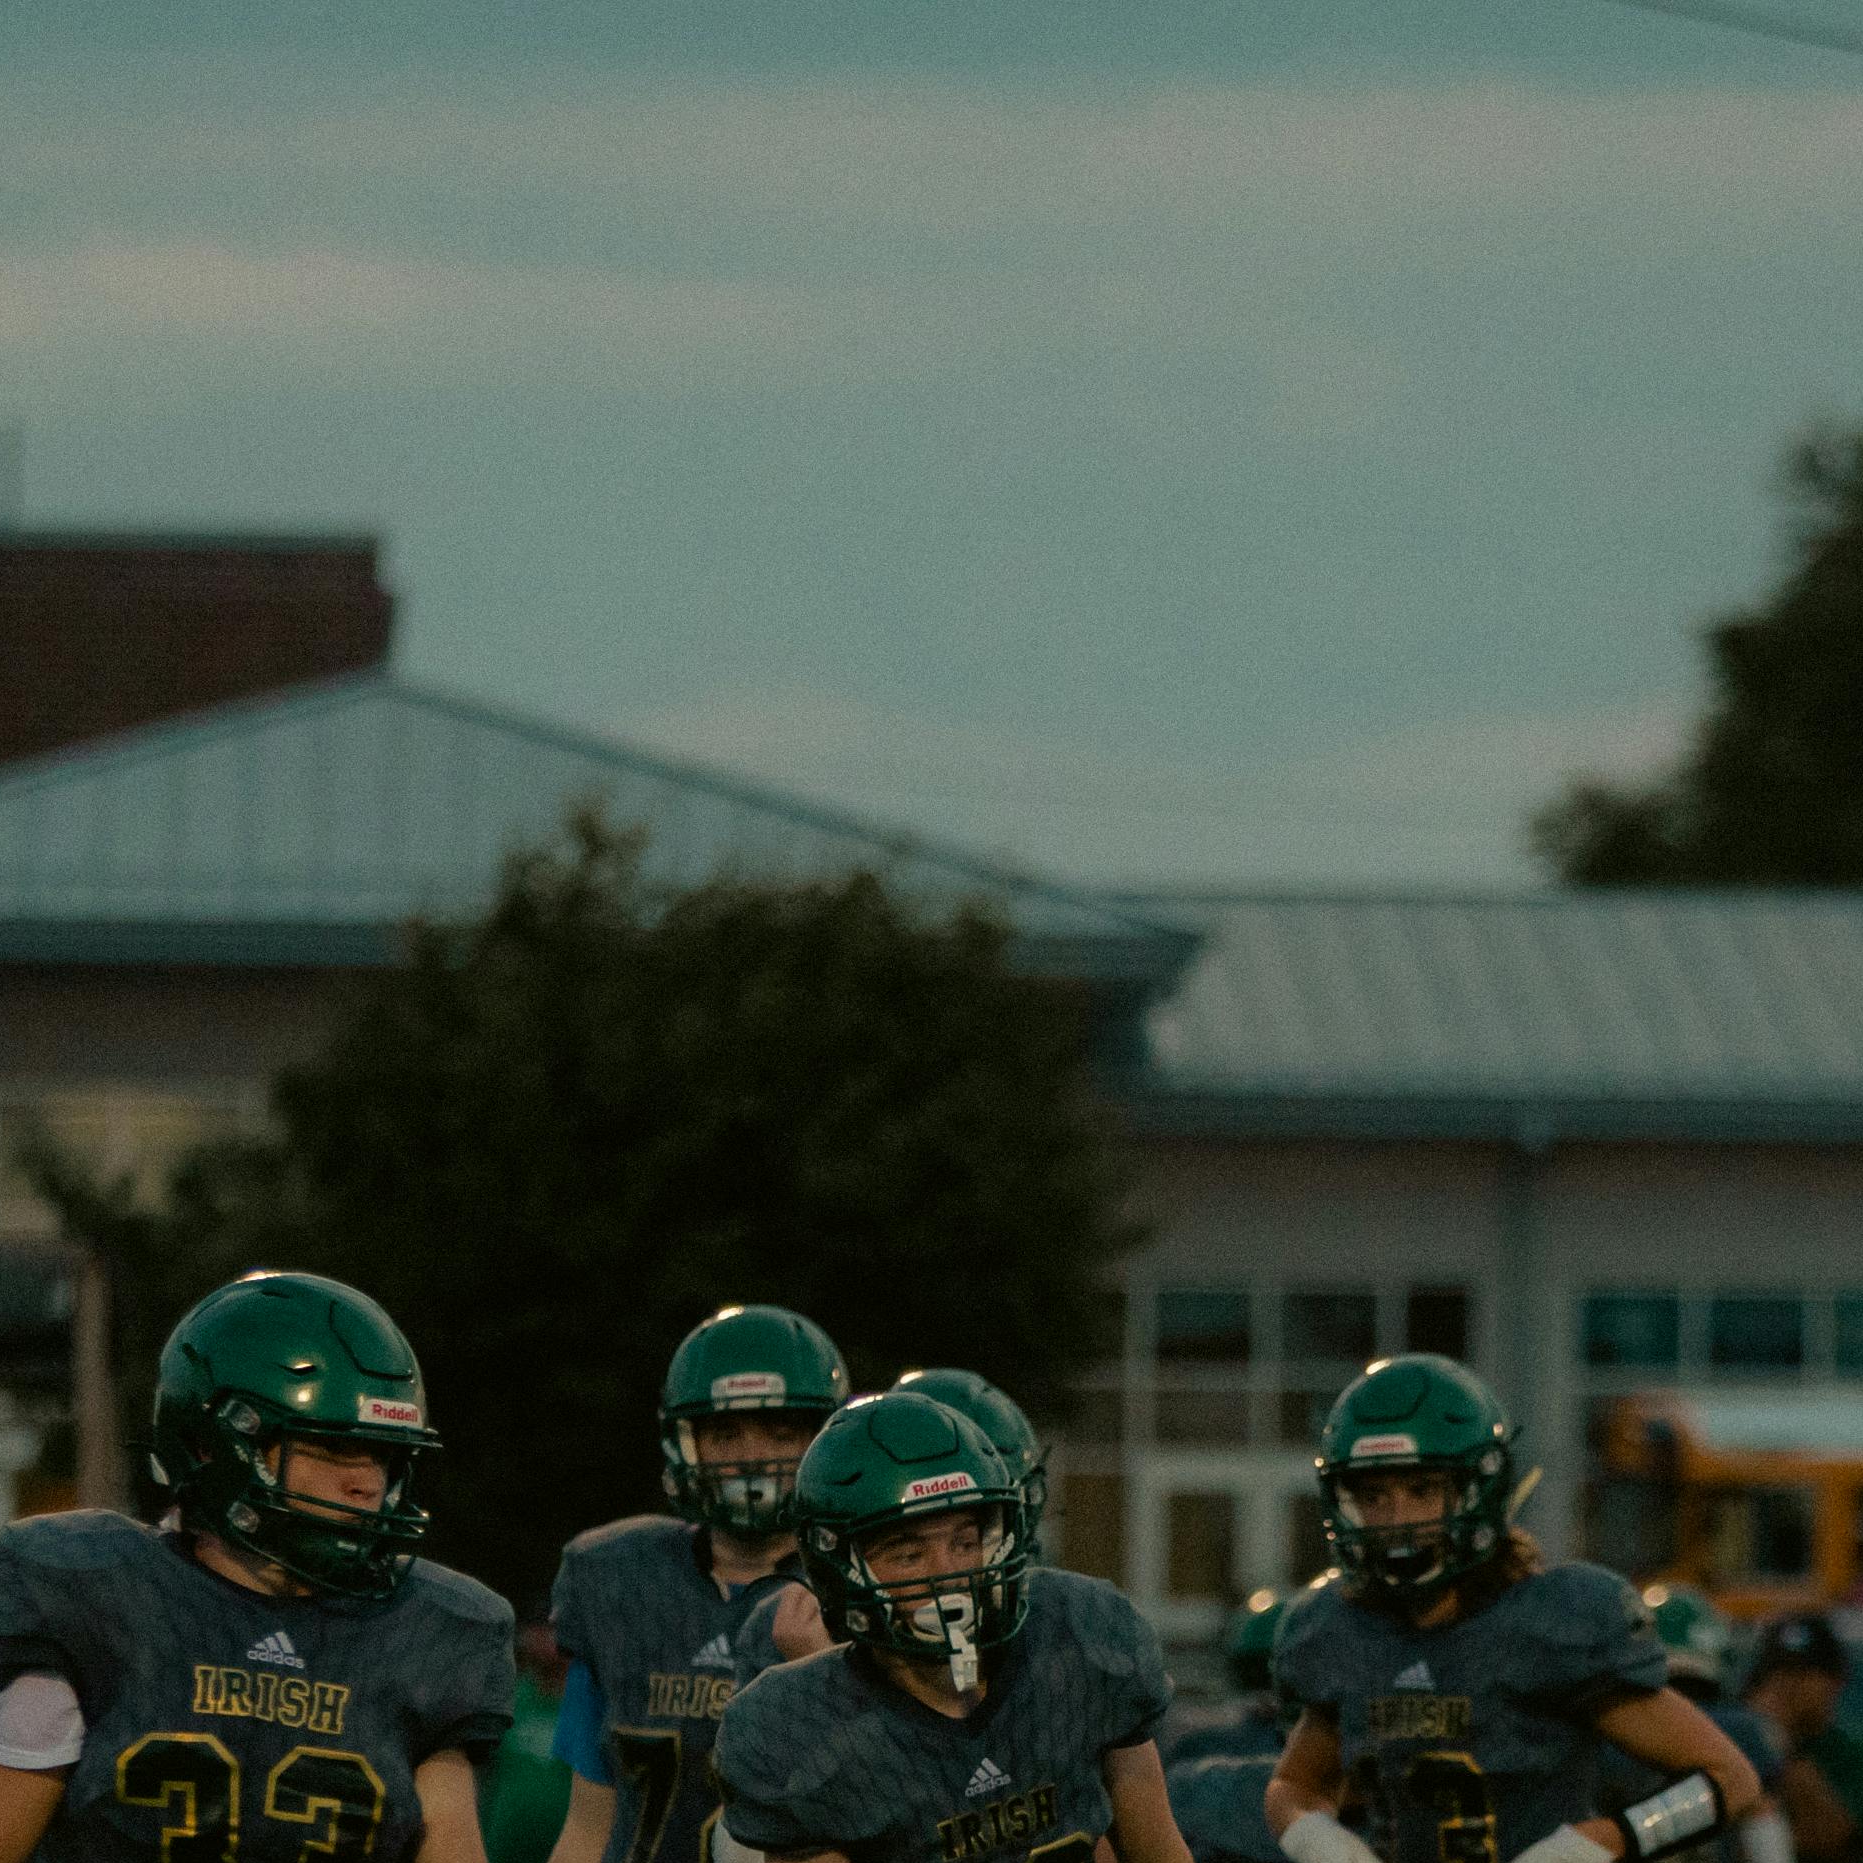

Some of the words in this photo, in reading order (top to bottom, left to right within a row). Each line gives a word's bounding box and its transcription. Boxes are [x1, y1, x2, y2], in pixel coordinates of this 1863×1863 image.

[372, 1404, 418, 1422] Riddell
[912, 1475, 968, 1497] Riddell
[246, 1649, 305, 1670] adidas
[192, 1663, 352, 1736] IRISH
[647, 1671, 739, 1720] IRIS
[965, 1773, 1012, 1797] adidas
[936, 1782, 1058, 1863] IRISH
